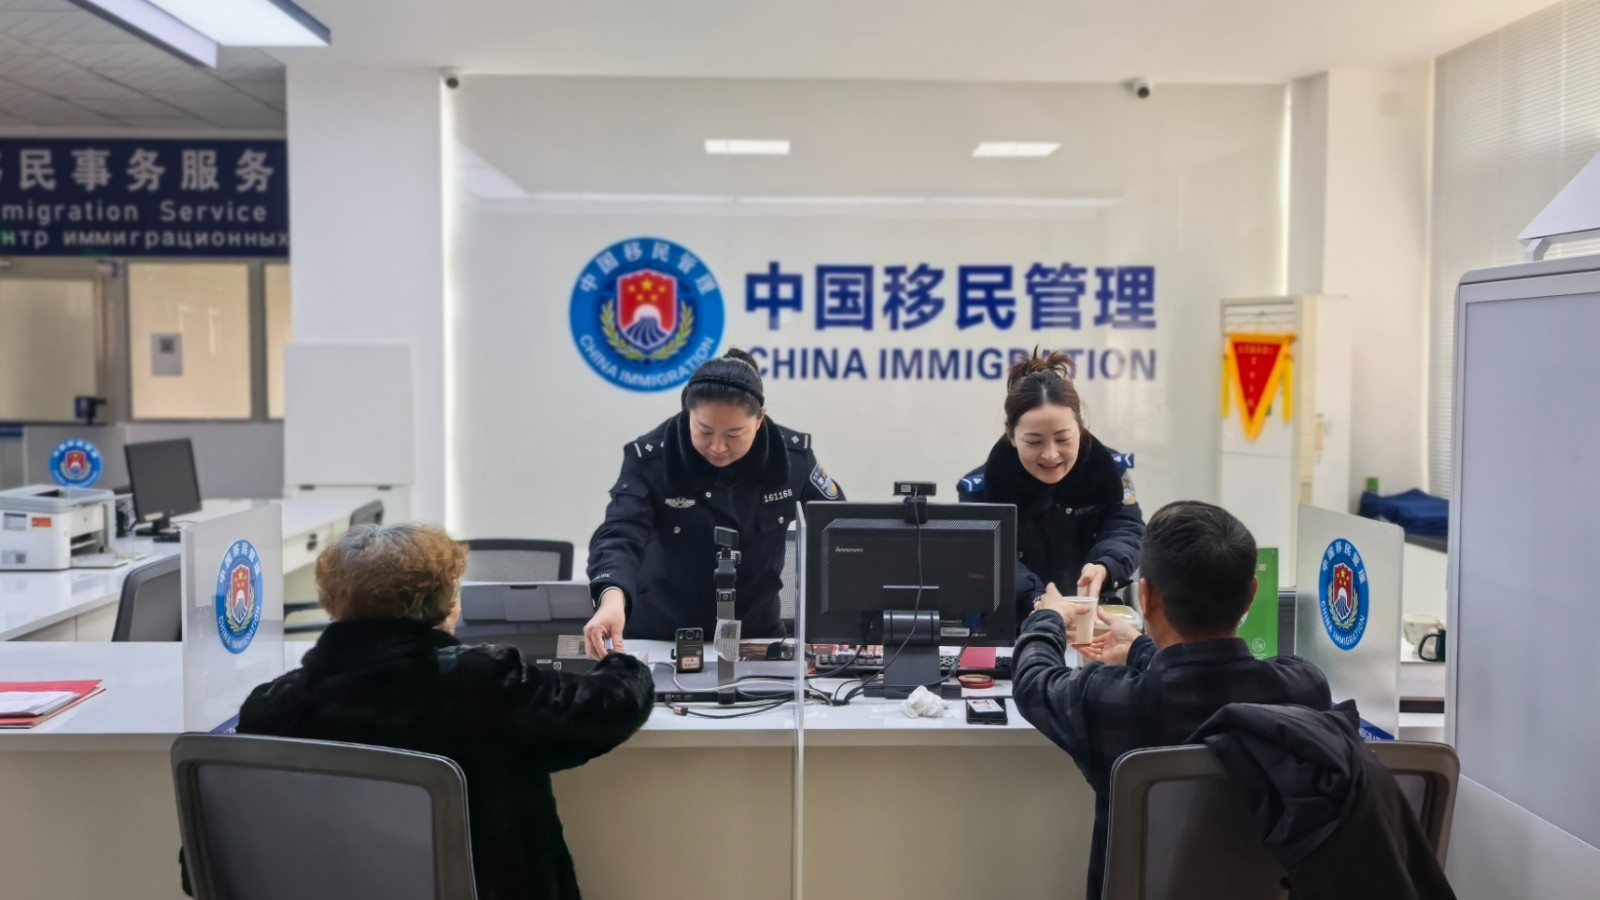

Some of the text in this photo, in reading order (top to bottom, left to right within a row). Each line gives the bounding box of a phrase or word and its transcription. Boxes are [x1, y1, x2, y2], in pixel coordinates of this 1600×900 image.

[0, 147, 274, 191] 民事务服务
[160, 200, 267, 222] Service
[580, 241, 717, 295] 中国移民管理
[745, 261, 1157, 331] 中国移民管理
[580, 335, 714, 386] CHINA IMMIGRATION
[748, 346, 1157, 380] CHINA IMMIGTION
[764, 488, 792, 502] 161168
